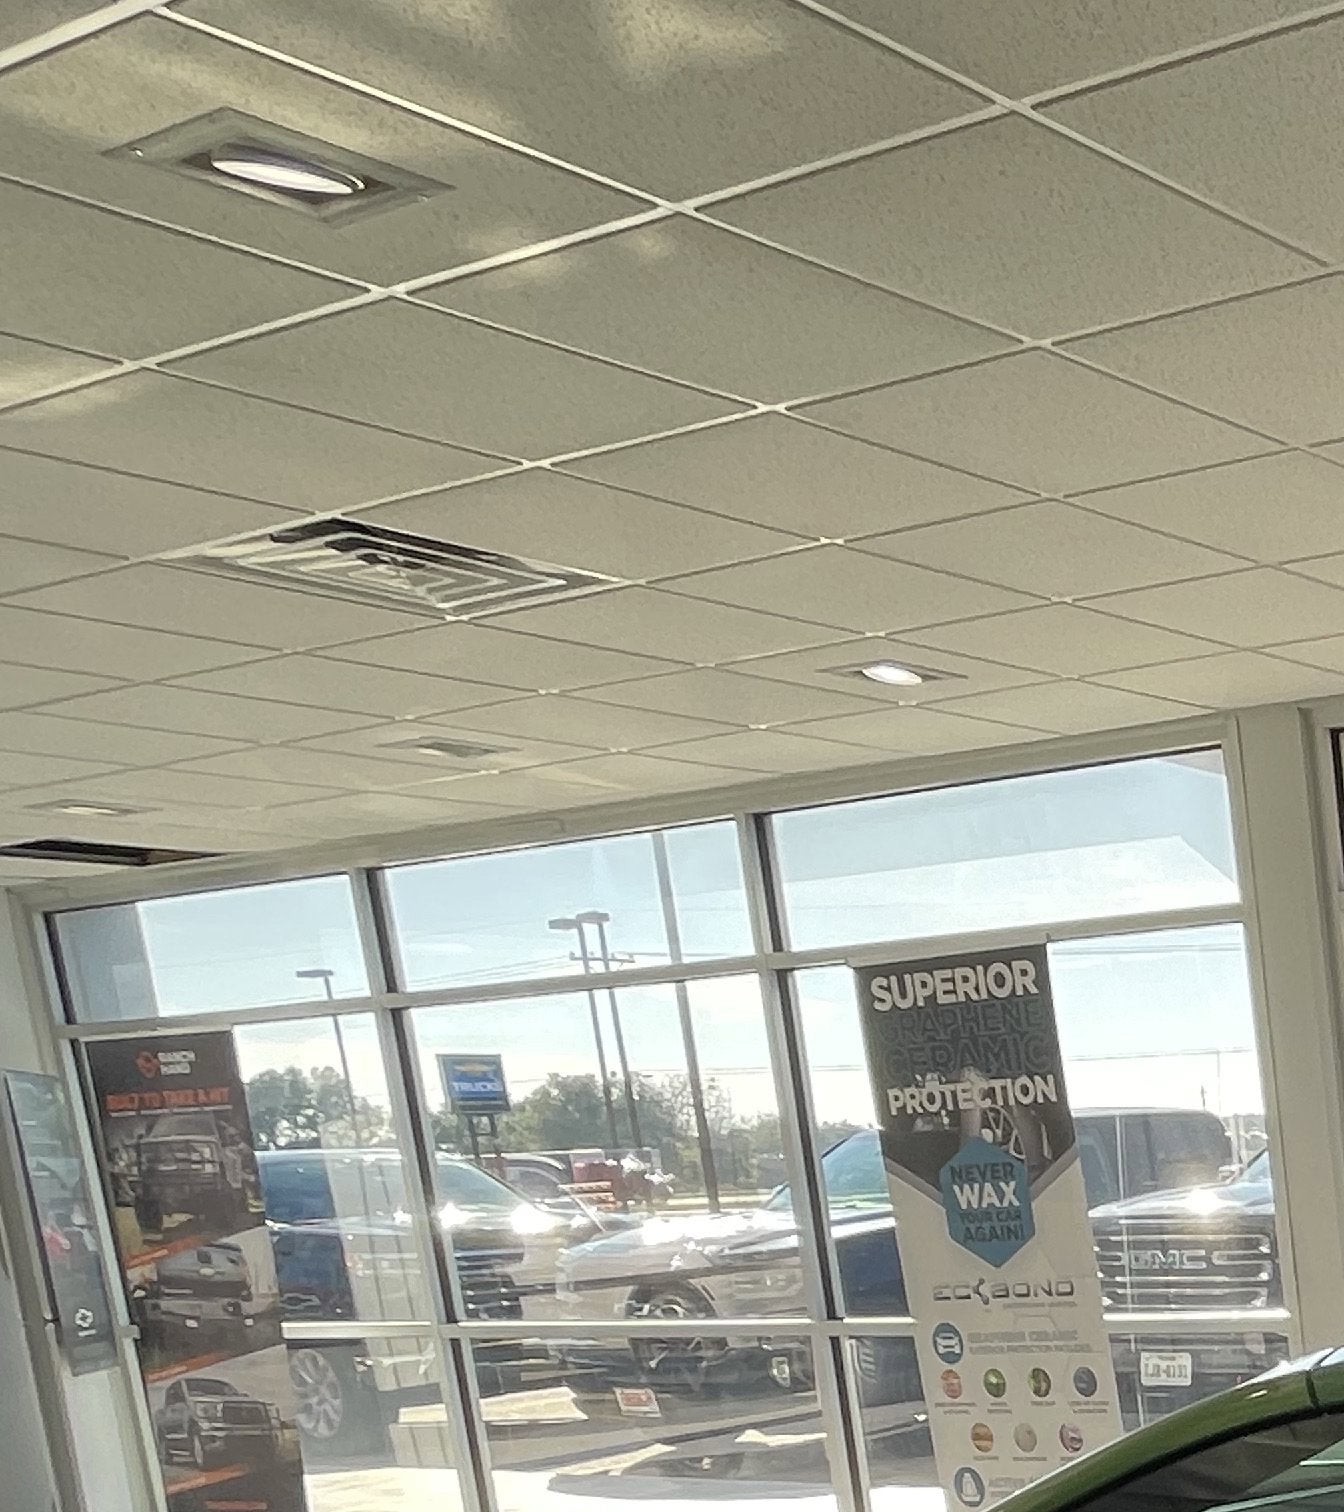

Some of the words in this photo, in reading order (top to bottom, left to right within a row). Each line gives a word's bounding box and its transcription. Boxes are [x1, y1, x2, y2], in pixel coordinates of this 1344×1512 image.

[870, 958, 1040, 1012] SUPERIOR
[878, 998, 1047, 1044] GRAPHENE
[882, 1033, 1054, 1078] CERAMIC
[887, 1073, 1058, 1117] PROTECTION
[950, 1161, 1017, 1183] NEVER
[952, 1180, 1021, 1210] WAX
[1131, 1249, 1207, 1270] GMC
